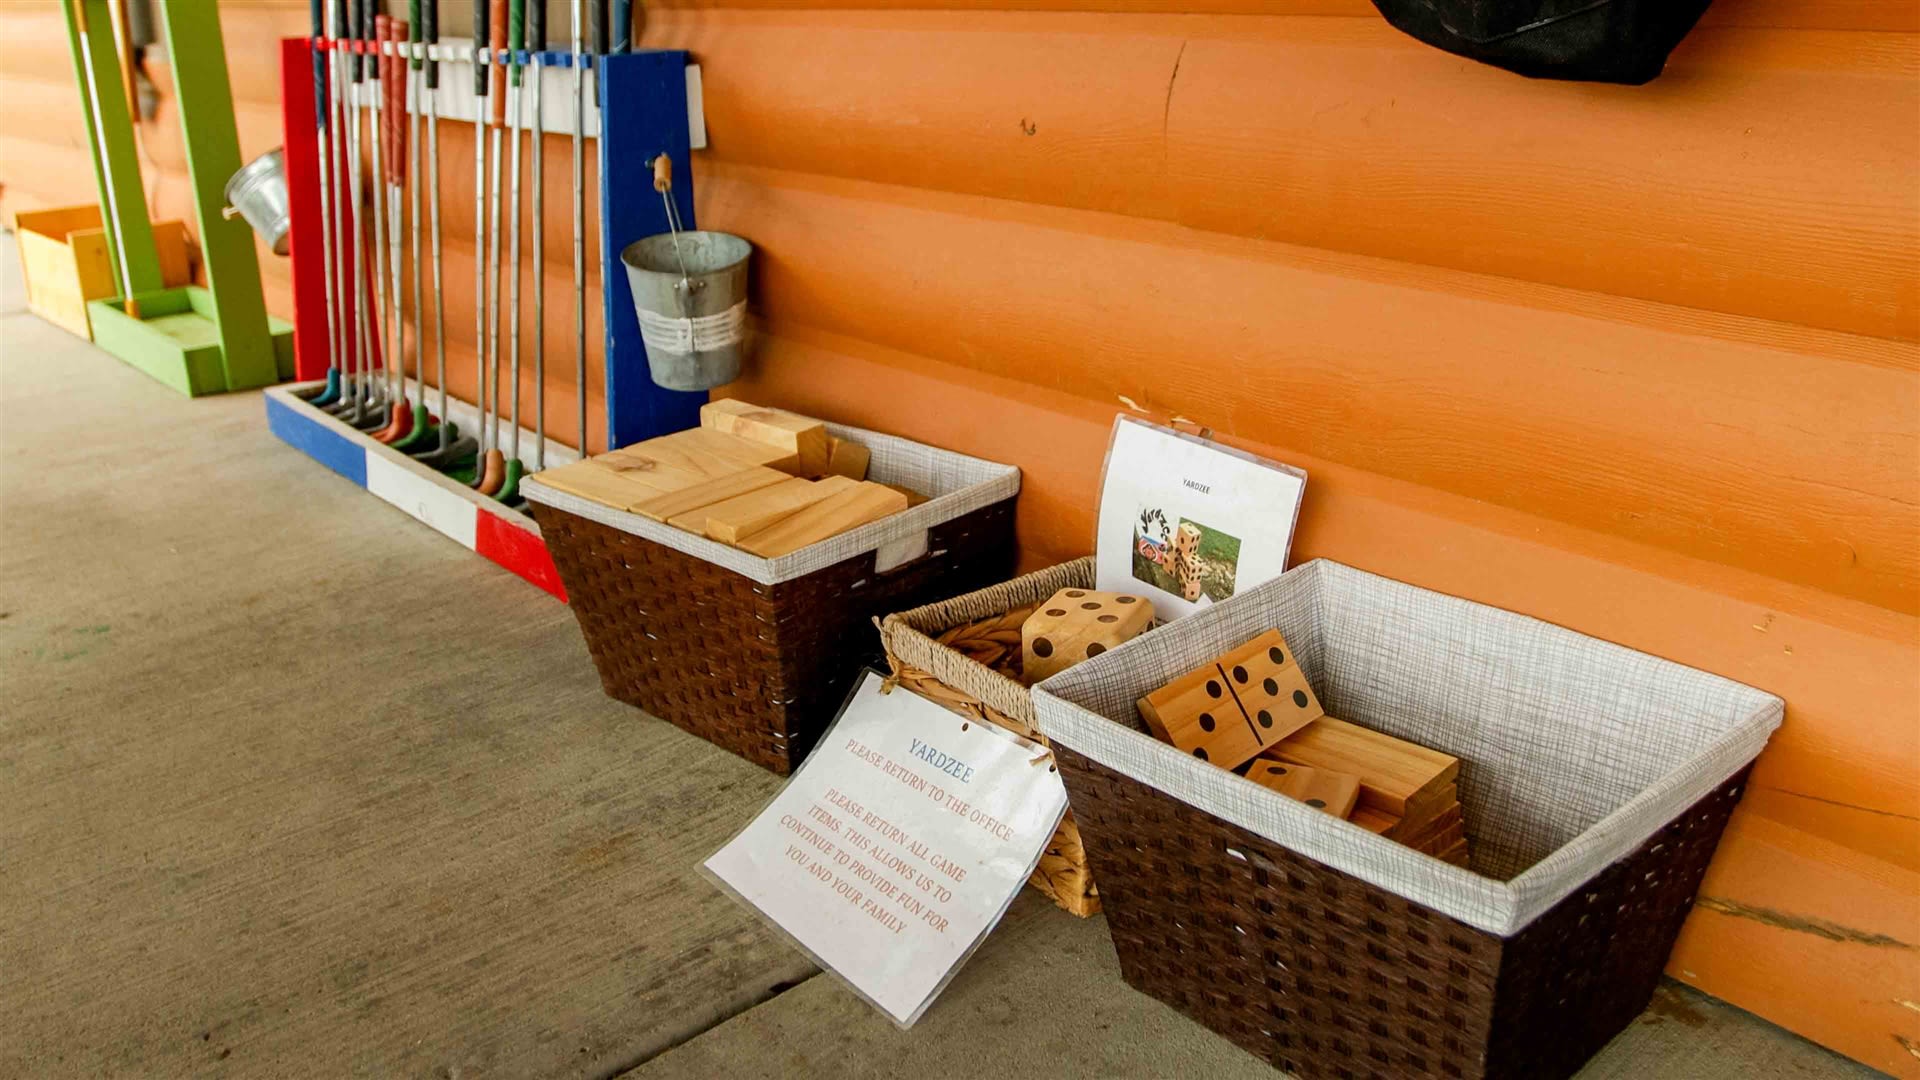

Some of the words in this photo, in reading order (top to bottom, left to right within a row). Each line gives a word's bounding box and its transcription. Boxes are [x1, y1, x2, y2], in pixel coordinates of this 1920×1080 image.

[1183, 478, 1210, 494] YARDZEE
[845, 739, 885, 770] PLEASE
[884, 759, 929, 792] RETURN
[929, 782, 945, 801] TO
[945, 791, 971, 814] THE
[969, 809, 1014, 841] OFFICE
[910, 738, 974, 784] YARDZEE
[780, 814, 834, 856] CONTINUE
[833, 849, 848, 865] TO
[848, 859, 899, 899] PROVIDE
[896, 890, 922, 915] FUN
[922, 908, 948, 933] FOR
[807, 806, 842, 832] ITEMS.
[843, 827, 870, 853] THIS
[870, 843, 916, 881] ALLOWS
[916, 873, 935, 891] US
[935, 884, 952, 903] TO
[824, 788, 865, 822] PLEASE
[863, 809, 909, 846] RETURN
[906, 836, 929, 859] ALL
[930, 852, 966, 882] GAME
[785, 845, 808, 869] YOU
[806, 862, 832, 883] AND
[831, 877, 864, 907] YOUR
[860, 898, 907, 934] FAMILY
